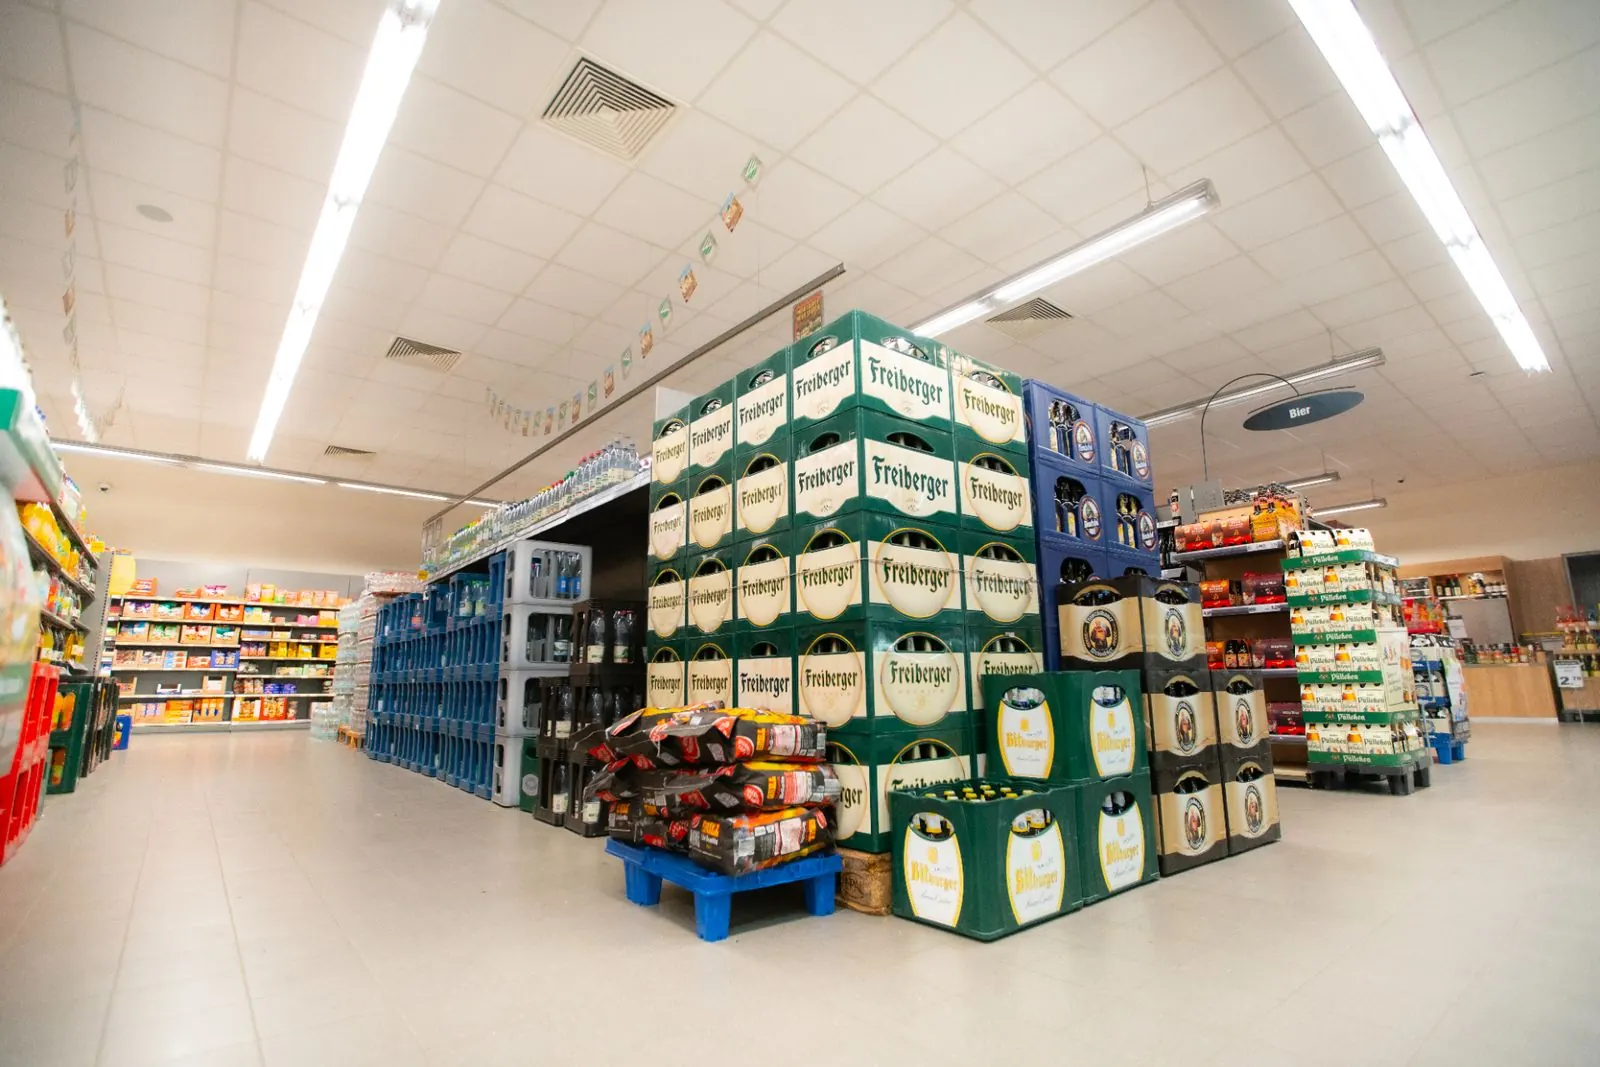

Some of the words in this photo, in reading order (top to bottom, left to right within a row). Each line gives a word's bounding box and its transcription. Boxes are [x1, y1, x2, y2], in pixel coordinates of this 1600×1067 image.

[795, 359, 851, 400] Freiberger
[868, 356, 943, 405] Freiberger
[739, 391, 784, 426] Freiberger
[963, 388, 1015, 424] Freiberger
[1289, 406, 1310, 418] Bier
[692, 417, 731, 440] Freiberger
[656, 441, 686, 463] Freiberger
[797, 460, 856, 494] Freiberger
[872, 456, 949, 500] Freiberger
[741, 482, 783, 509] Freiberger
[970, 477, 1023, 509] Freiberger
[653, 514, 682, 534] Freiberger
[692, 499, 728, 523] Freiberger
[743, 576, 785, 598] Freiberger
[803, 563, 854, 589] Freiberger
[883, 557, 950, 592] Freiberger
[976, 573, 1030, 600] Freiberger
[652, 594, 682, 611] Freiberger
[692, 587, 728, 606] Freiberger
[650, 674, 681, 694] Freiberger
[692, 674, 728, 694] Freiberger
[740, 672, 790, 698] Freiberger
[805, 669, 858, 690] Freiberger
[889, 661, 952, 687] Freiberger
[1006, 732, 1046, 750] Bitburger
[1097, 731, 1130, 752] Bitburger
[1106, 840, 1138, 864] Bitburger
[911, 861, 957, 892] Bitburger
[1016, 867, 1057, 894] Bitburger
